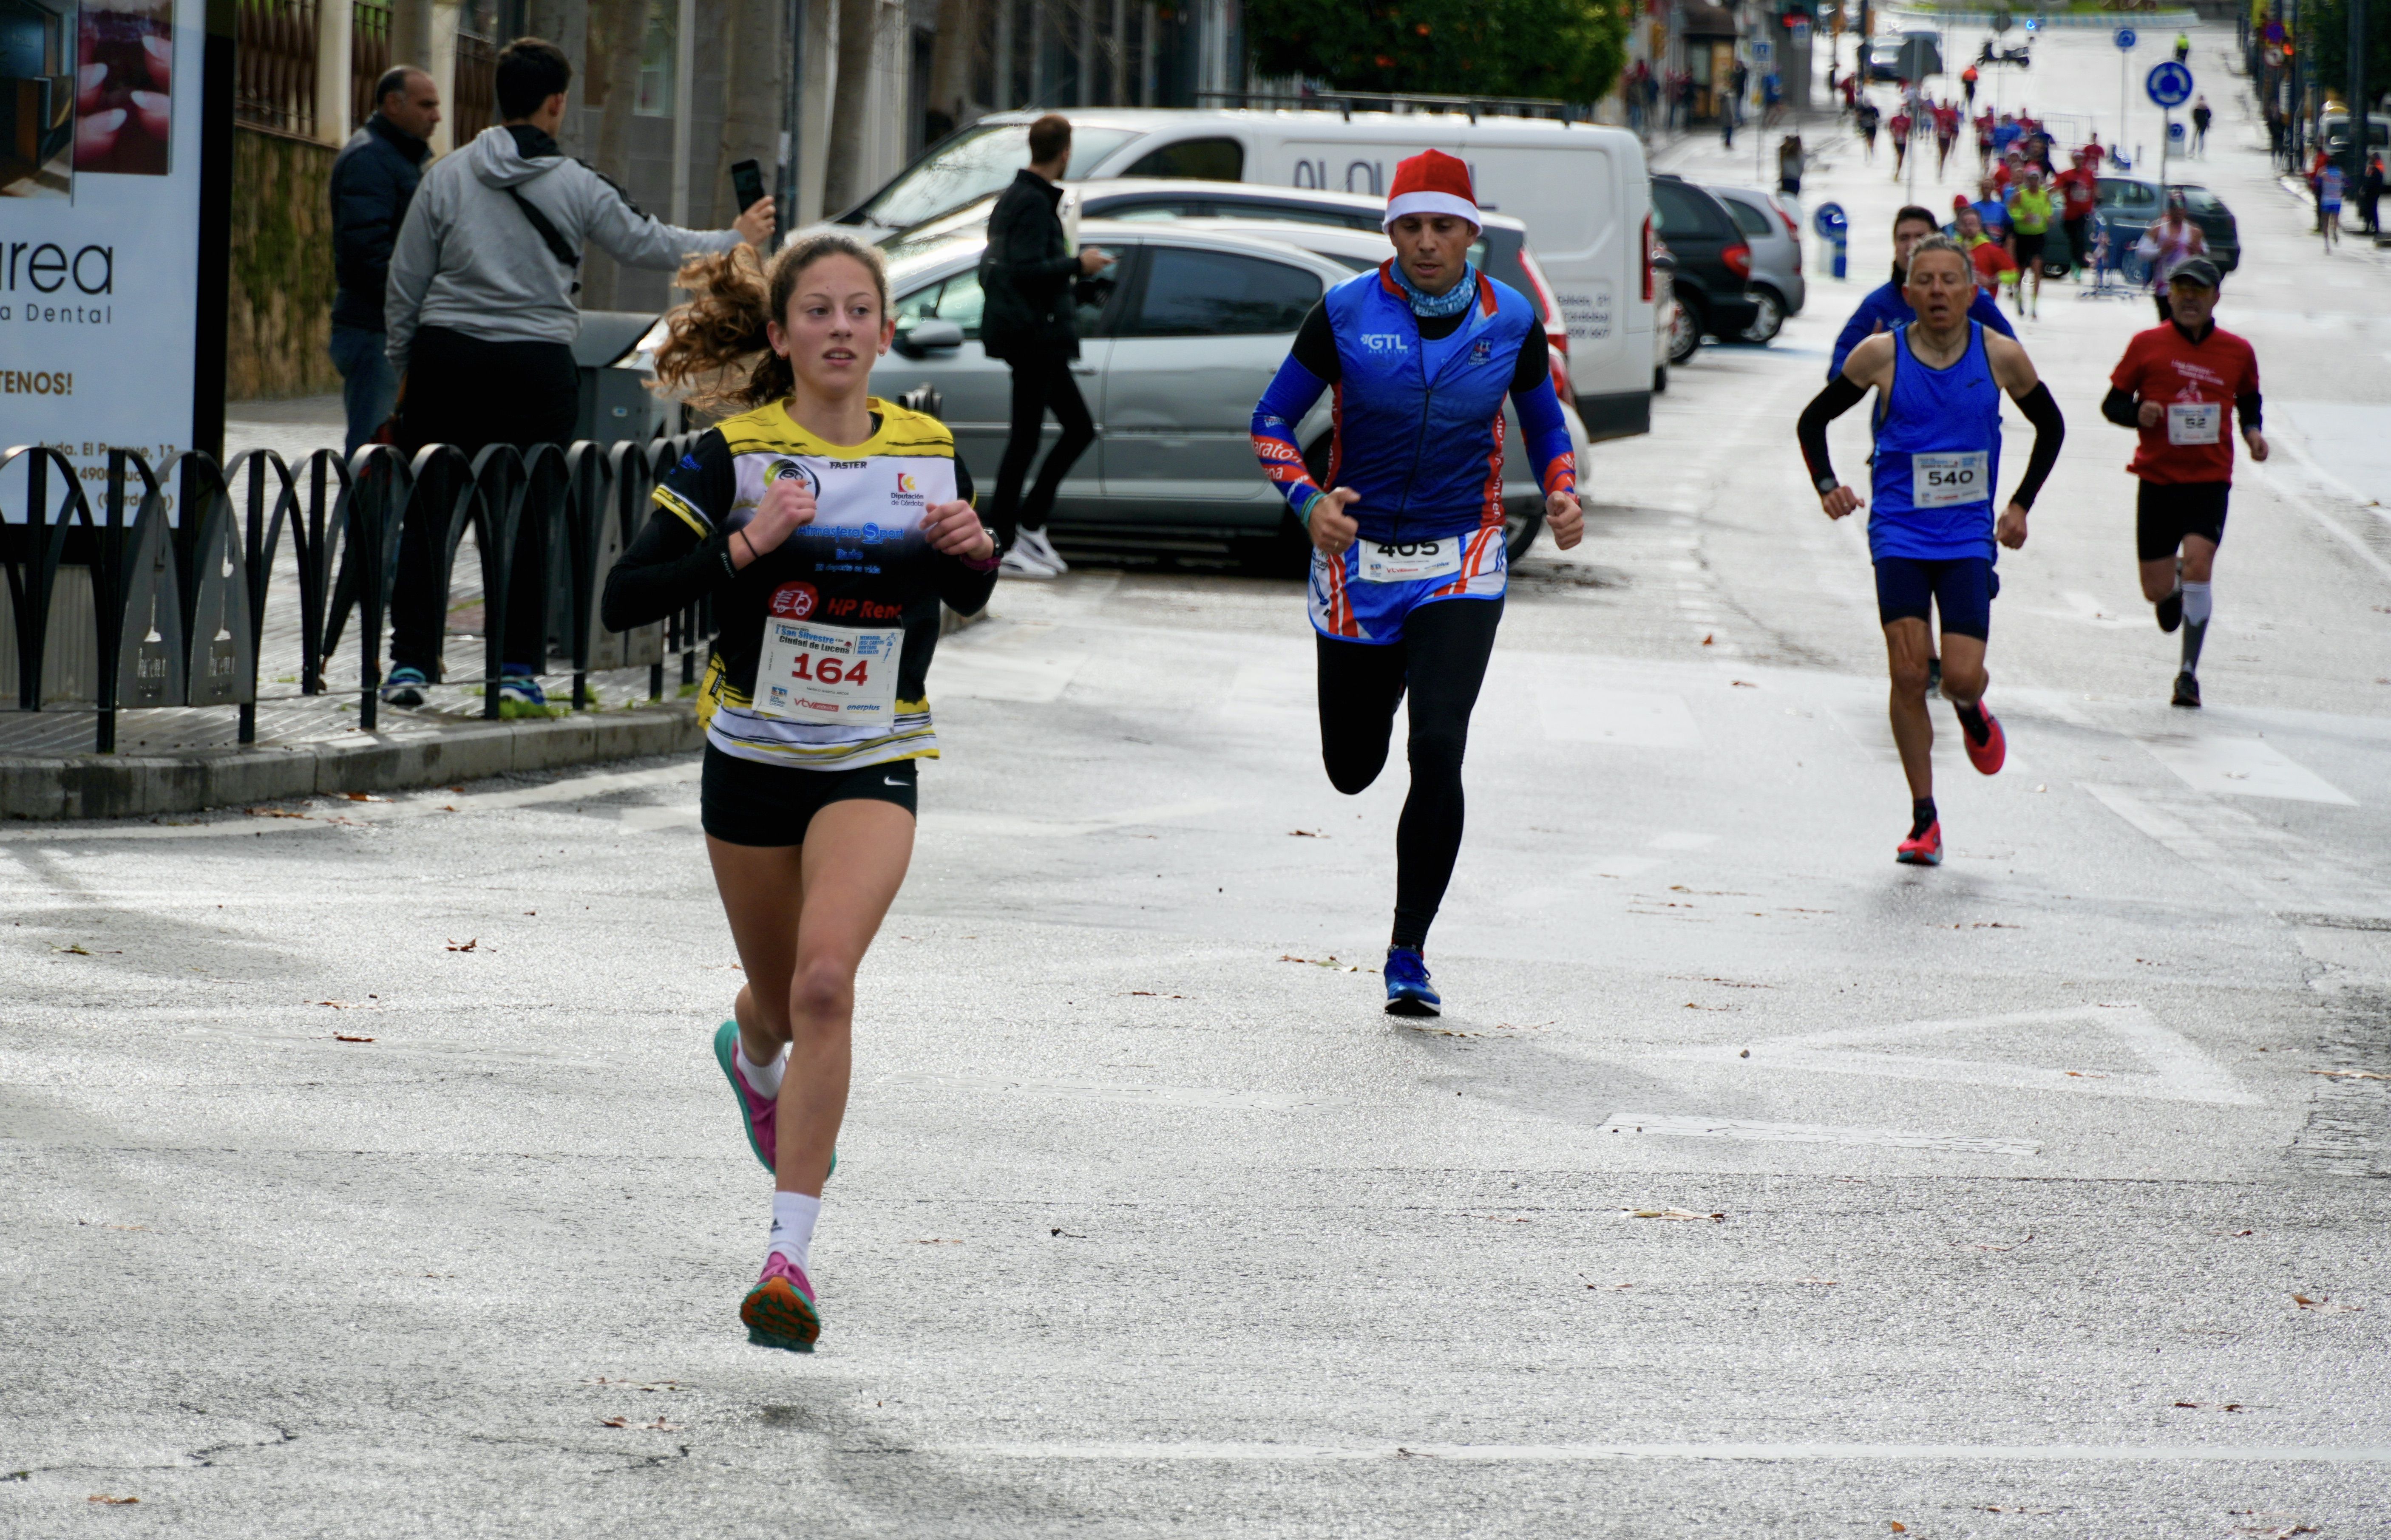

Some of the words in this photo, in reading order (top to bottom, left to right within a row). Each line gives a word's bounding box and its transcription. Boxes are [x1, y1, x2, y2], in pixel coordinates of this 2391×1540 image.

[0, 242, 113, 294] rea
[27, 303, 111, 324] Dental
[1368, 334, 1408, 350] GTL
[83, 442, 94, 456] El
[830, 461, 867, 469] FASTER
[1929, 470, 1974, 486] 540
[797, 524, 861, 543] Atmósfera
[827, 598, 857, 616] HP
[779, 635, 808, 648] Ciudad
[809, 642, 820, 650] de
[821, 643, 850, 654] Lucena
[781, 628, 797, 637] San
[798, 631, 834, 644] Silvestre
[791, 653, 868, 686] 164
[794, 697, 815, 709] vtv
